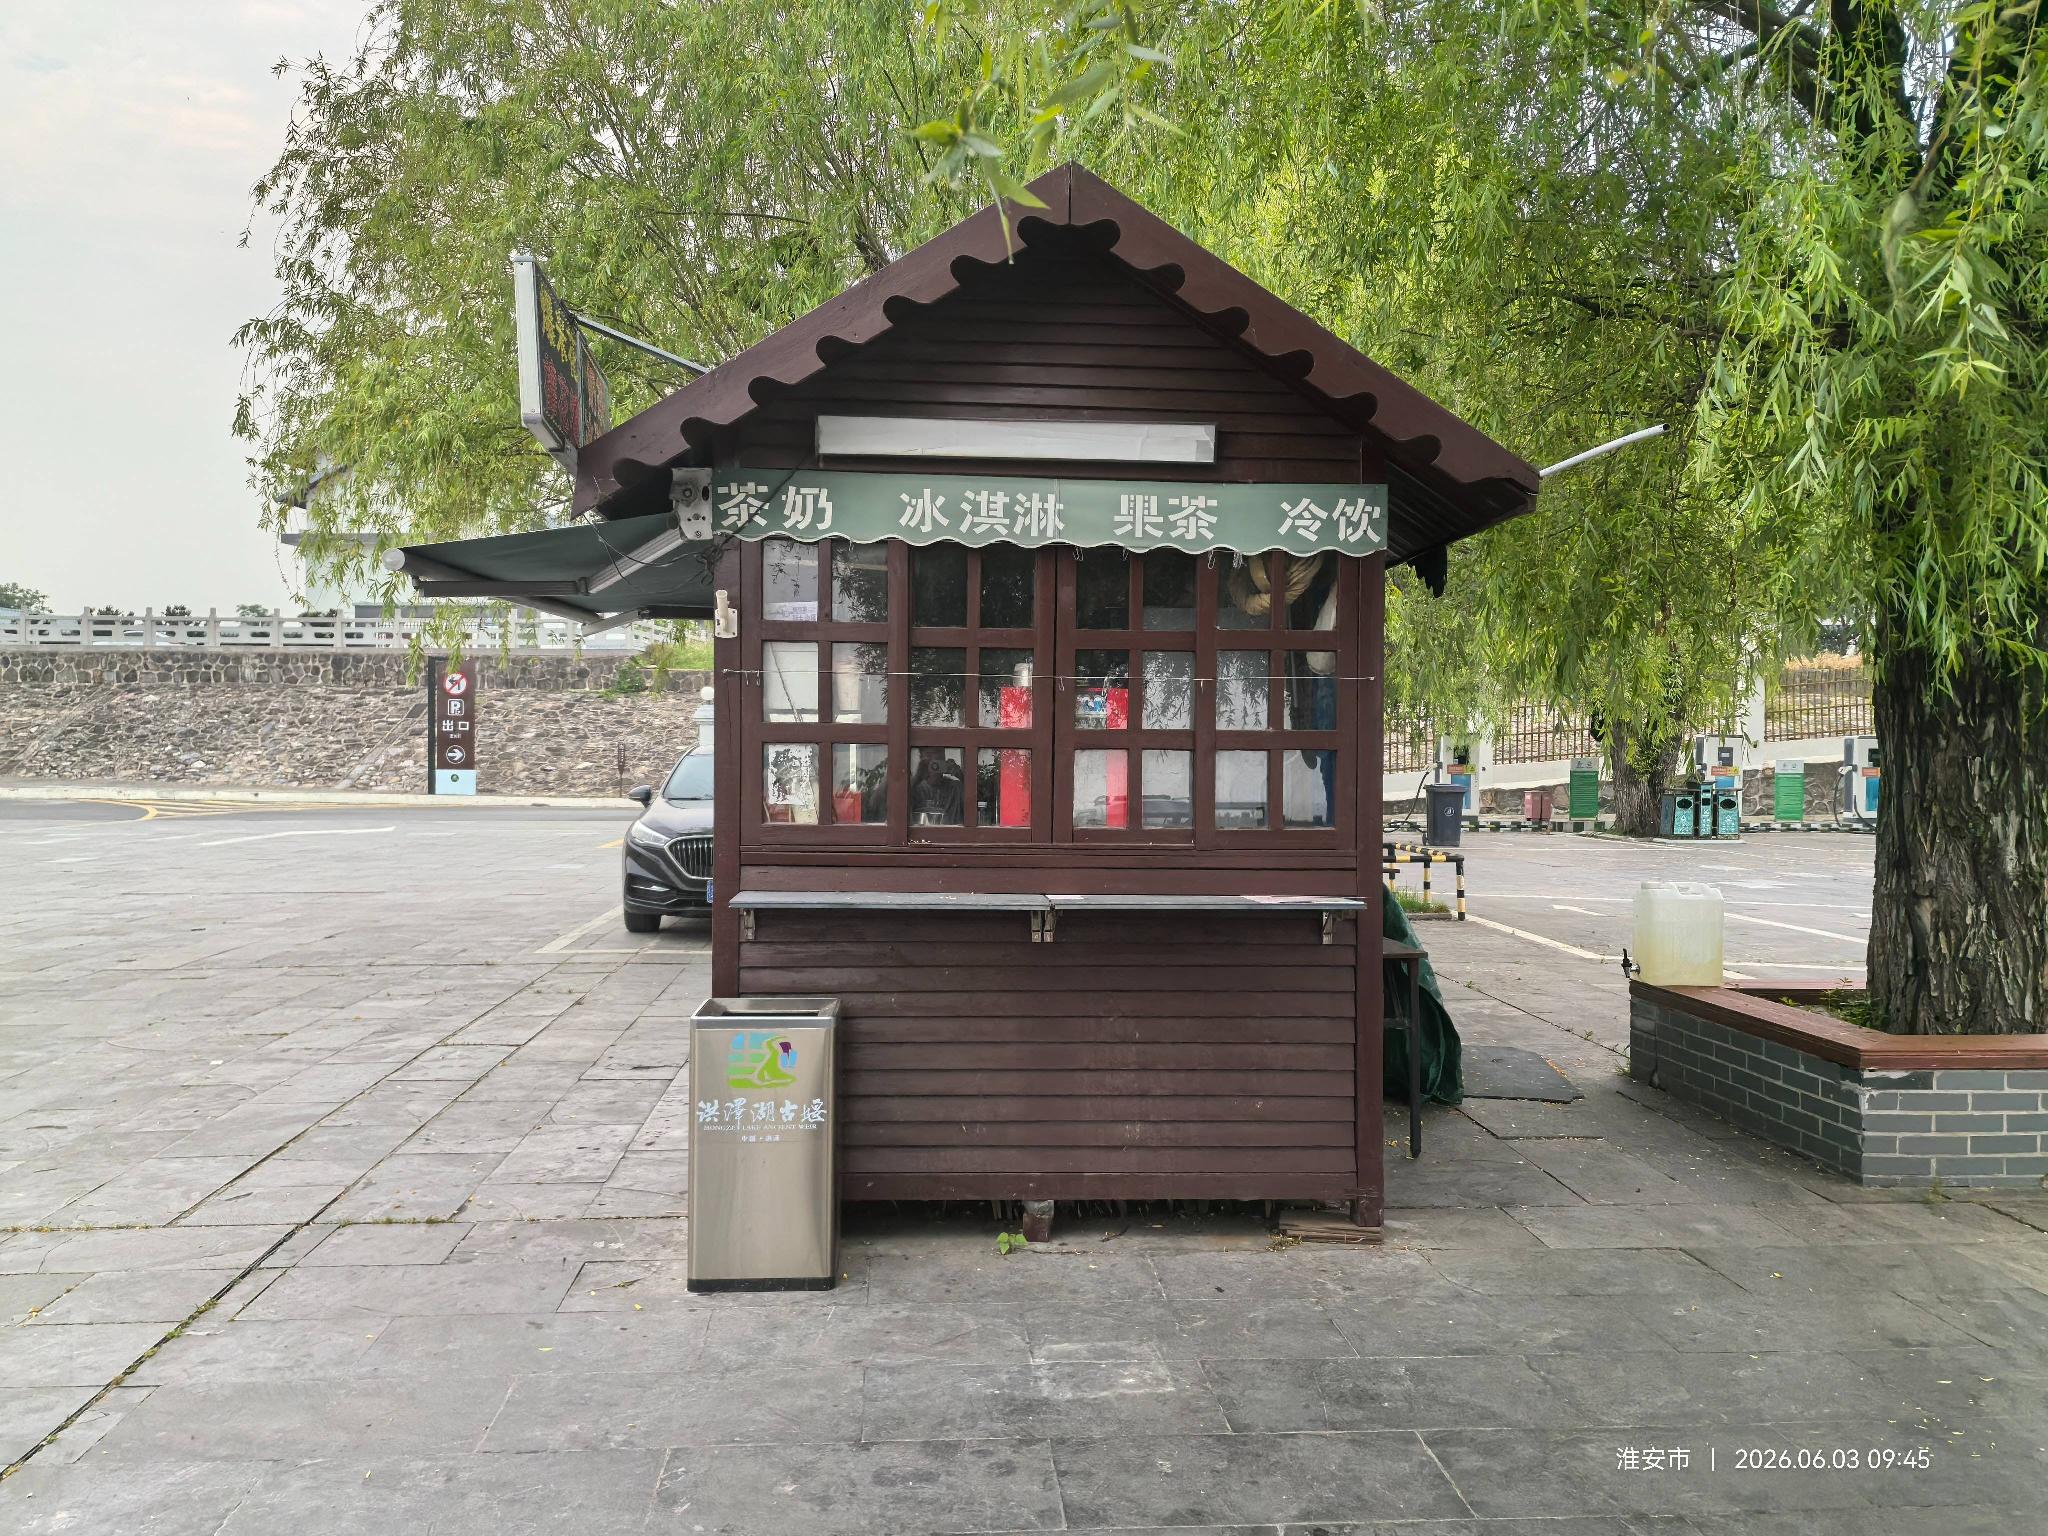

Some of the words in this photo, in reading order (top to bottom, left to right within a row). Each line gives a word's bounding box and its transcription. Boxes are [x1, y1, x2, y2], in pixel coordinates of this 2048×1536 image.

[717, 482, 833, 530] 茶奶
[899, 488, 1065, 538] 冰淇淋
[1113, 494, 1218, 540] 果茶
[1278, 498, 1381, 543] 冷饮
[442, 720, 469, 731] 出口
